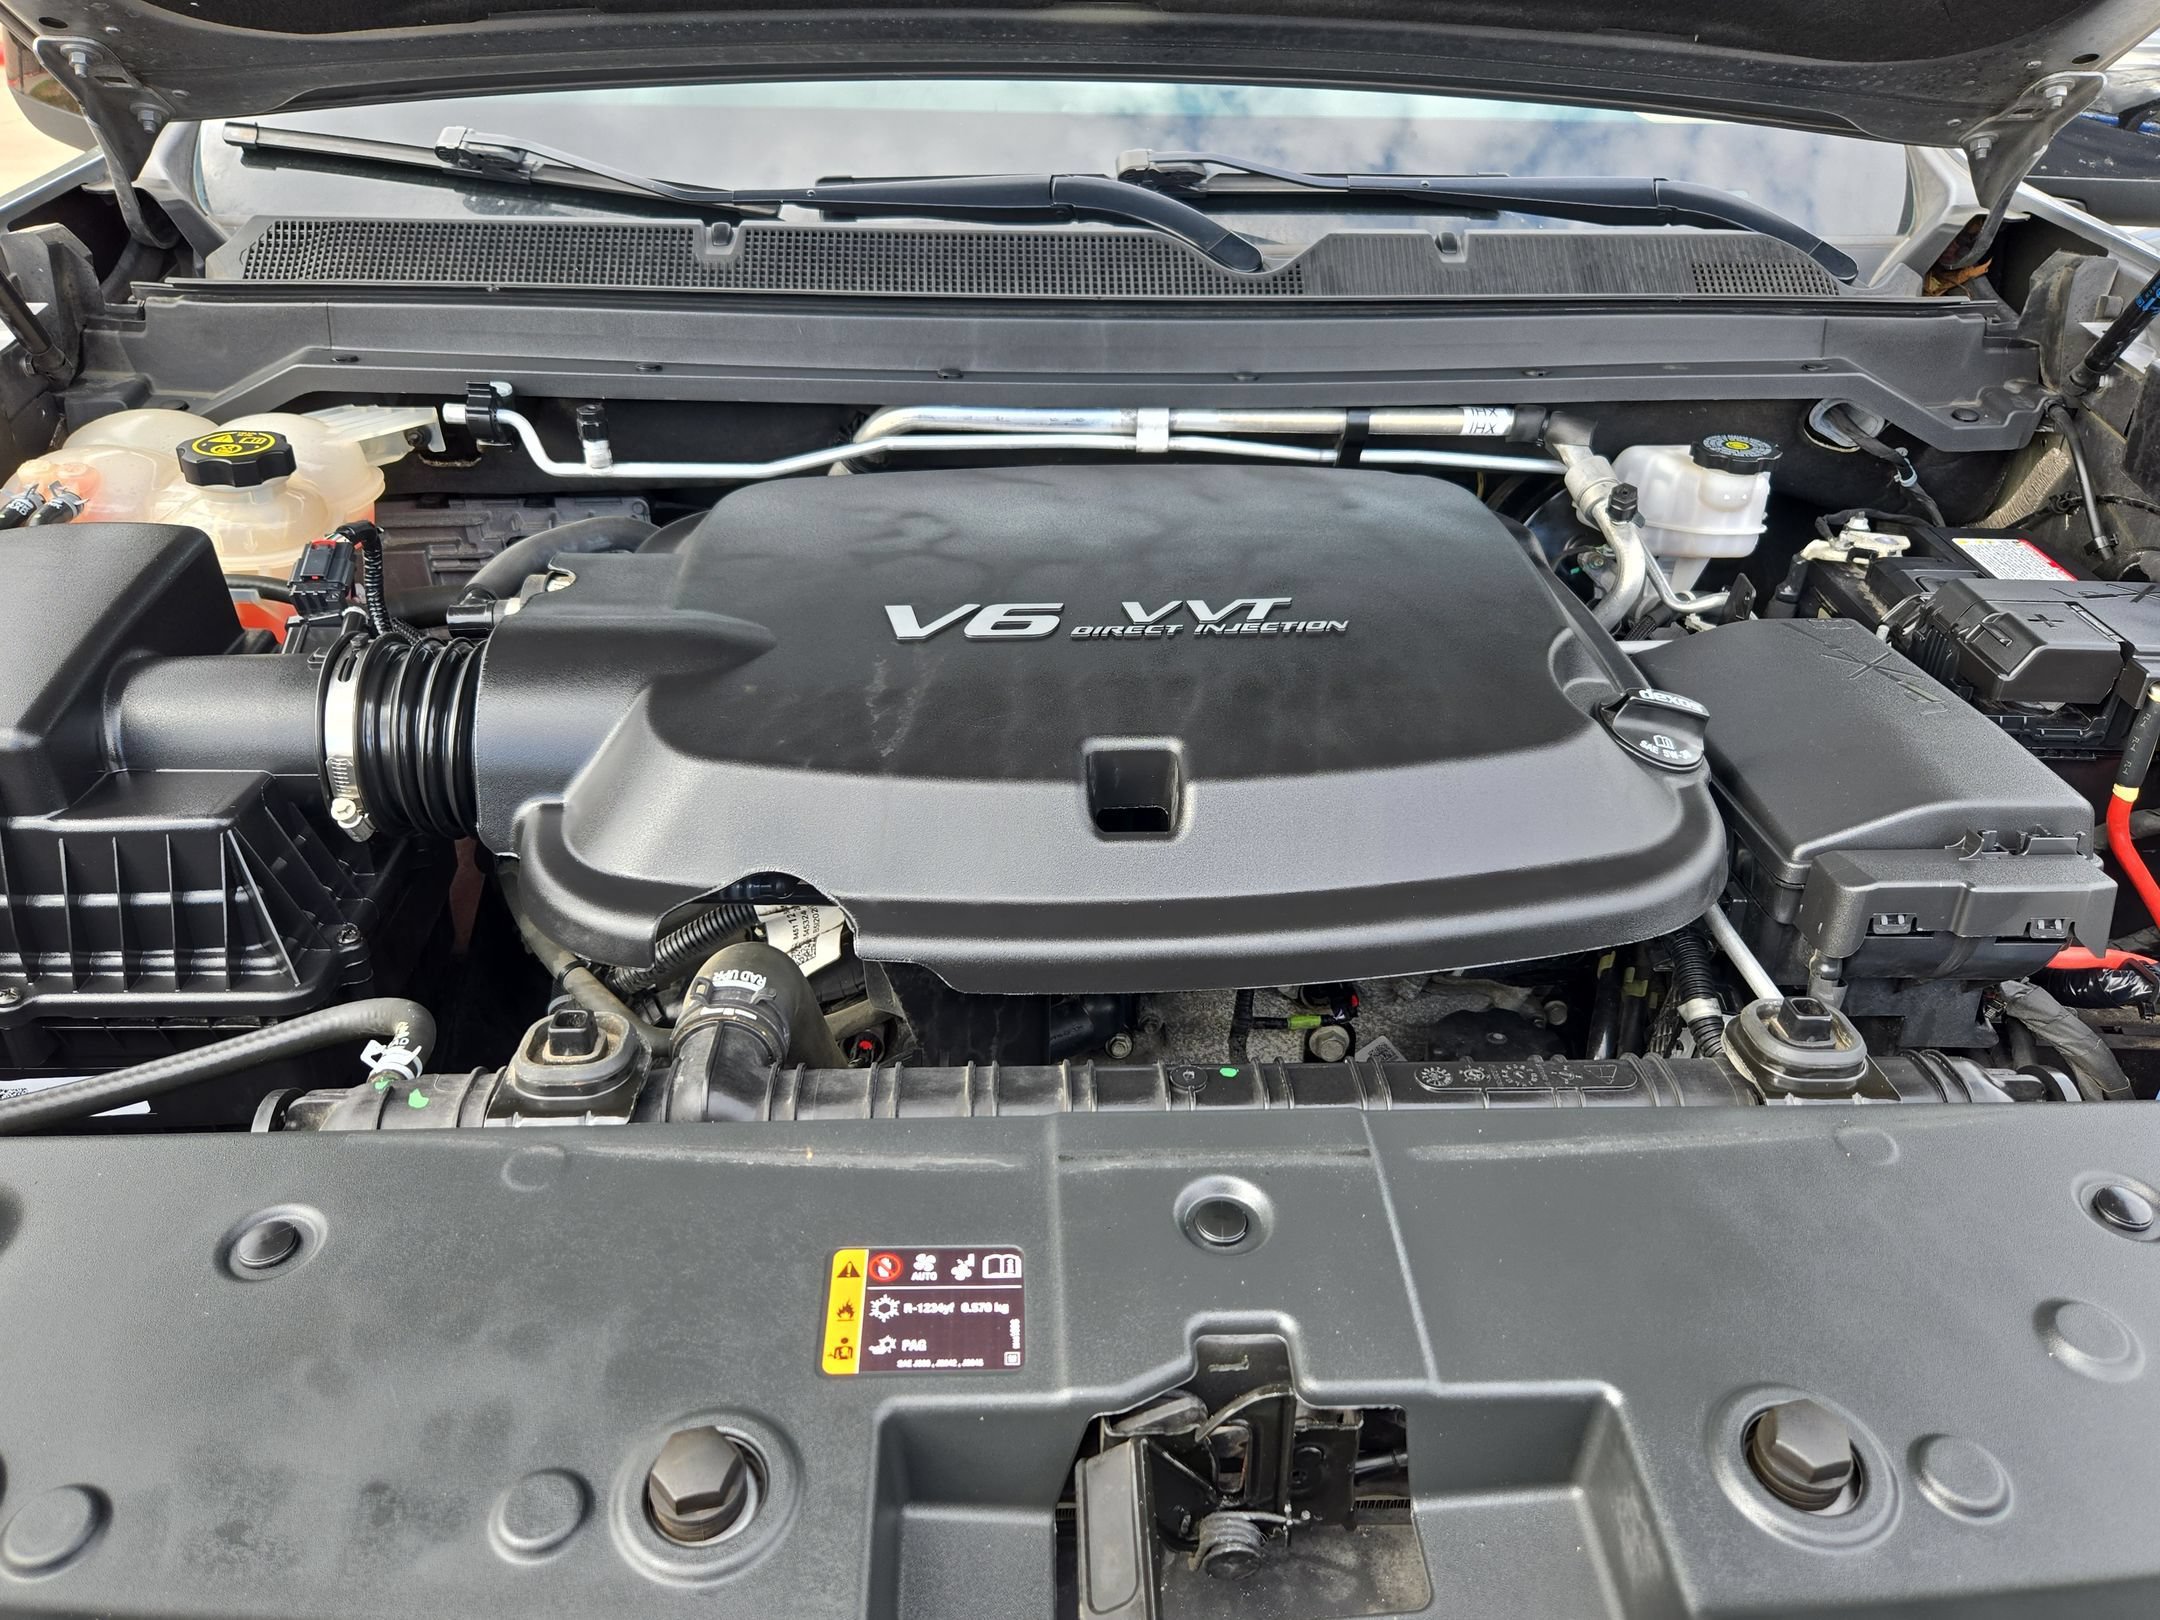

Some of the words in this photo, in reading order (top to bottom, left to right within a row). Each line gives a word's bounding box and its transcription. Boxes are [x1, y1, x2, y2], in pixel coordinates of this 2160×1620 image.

[884, 602, 1065, 640] V6
[1121, 597, 1293, 624] VVT
[1070, 624, 1185, 641] DIRECT
[1194, 619, 1349, 637] INJECTION
[1639, 688, 1704, 713] dexos
[1639, 740, 1660, 755] SAE
[740, 970, 767, 987] RAD
[911, 1272, 938, 1281] AUTO
[901, 1338, 927, 1351] PAG
